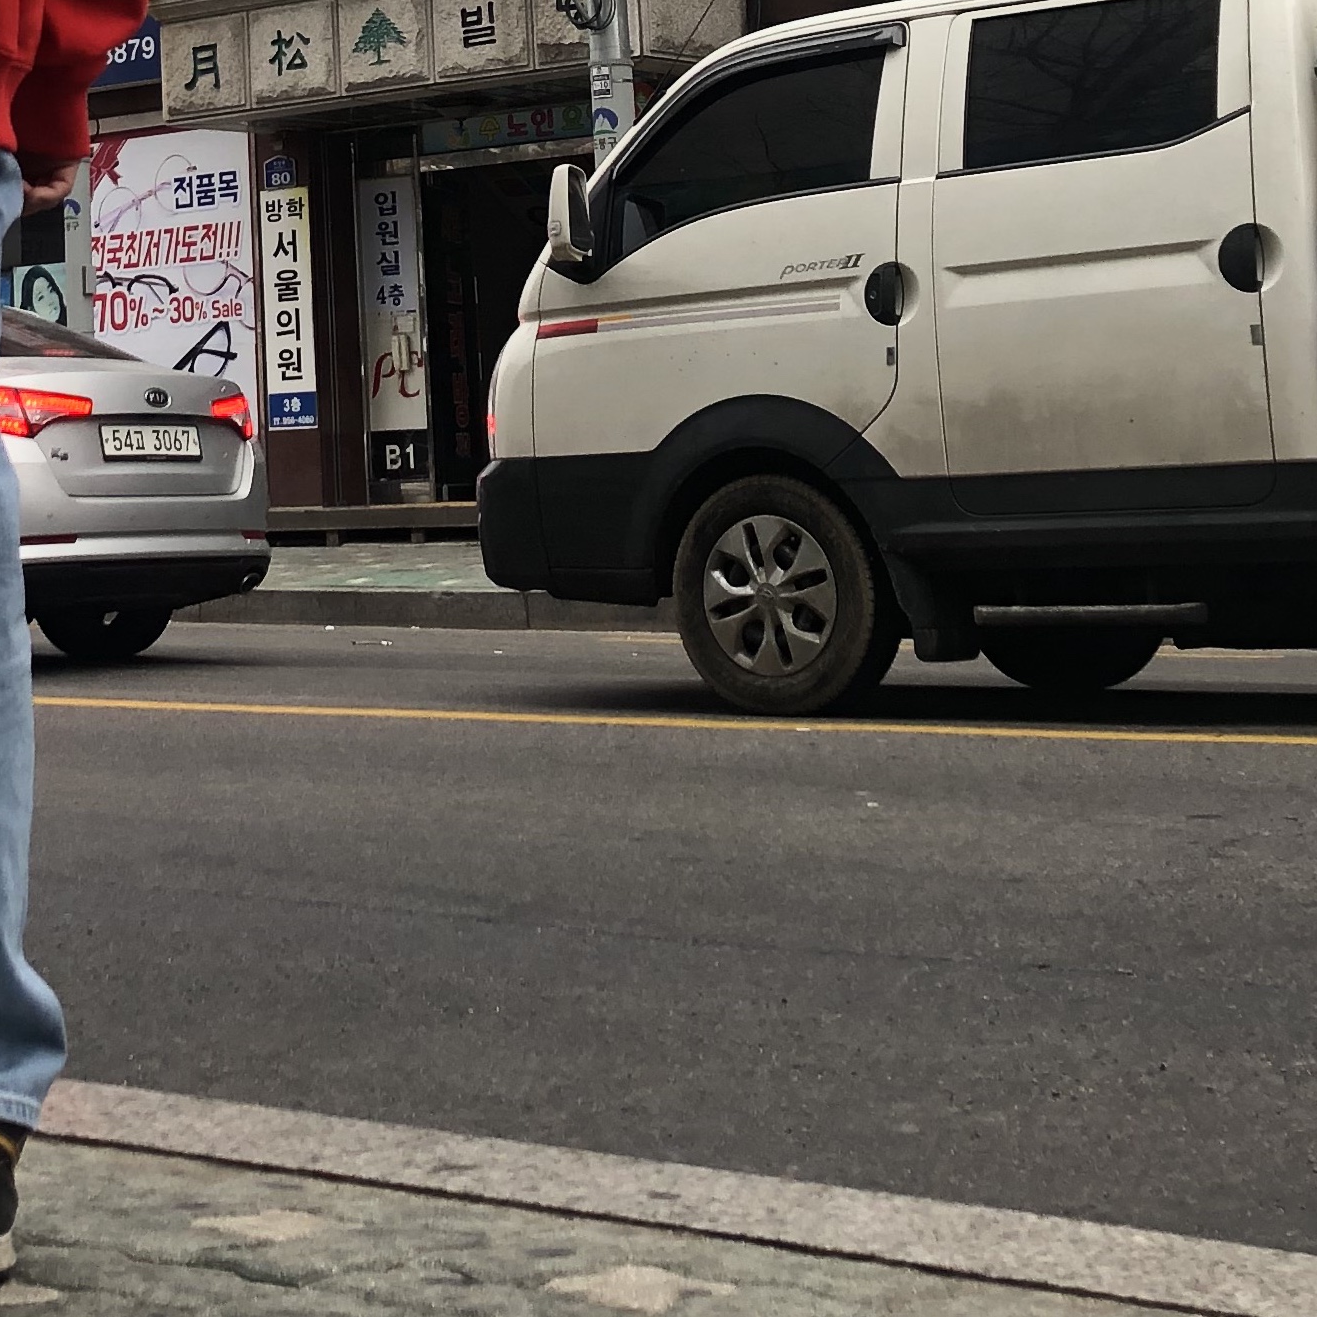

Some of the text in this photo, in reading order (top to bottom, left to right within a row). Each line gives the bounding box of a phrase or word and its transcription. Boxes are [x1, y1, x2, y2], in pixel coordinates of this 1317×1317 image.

[174, 171, 239, 209] 전품목
[271, 171, 290, 185] 80
[265, 196, 305, 222] 방학
[374, 190, 400, 276] 입원실
[273, 229, 303, 381] 서울의원
[376, 284, 405, 306] 4층
[212, 300, 242, 319] Sale
[152, 430, 190, 452] 3067
[385, 443, 415, 470] B1
